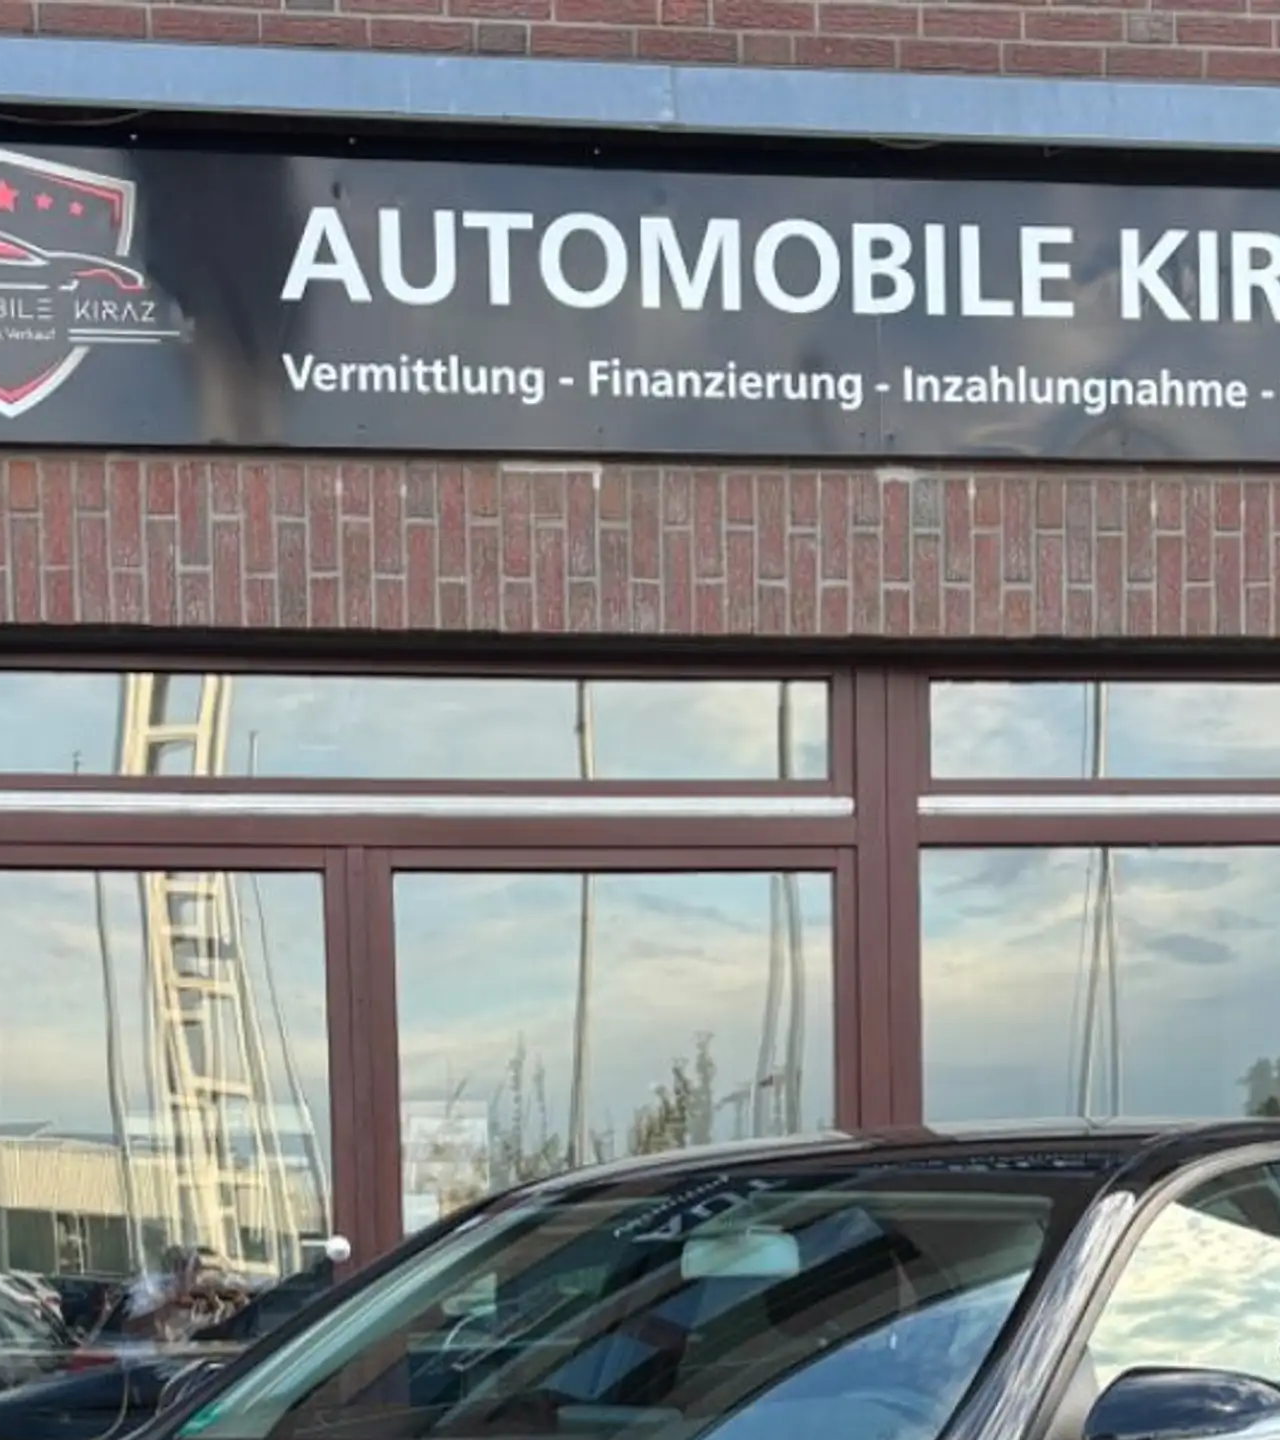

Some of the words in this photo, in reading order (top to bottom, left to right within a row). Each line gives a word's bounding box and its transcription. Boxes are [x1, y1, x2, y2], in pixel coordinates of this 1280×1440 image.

[281, 206, 1075, 319] AUTOMOBILE
[74, 299, 157, 323] KIRAZ
[282, 353, 545, 405] Vermittlung
[588, 358, 863, 410] Finanzierung
[903, 365, 1248, 415] Inzahlungnahme
